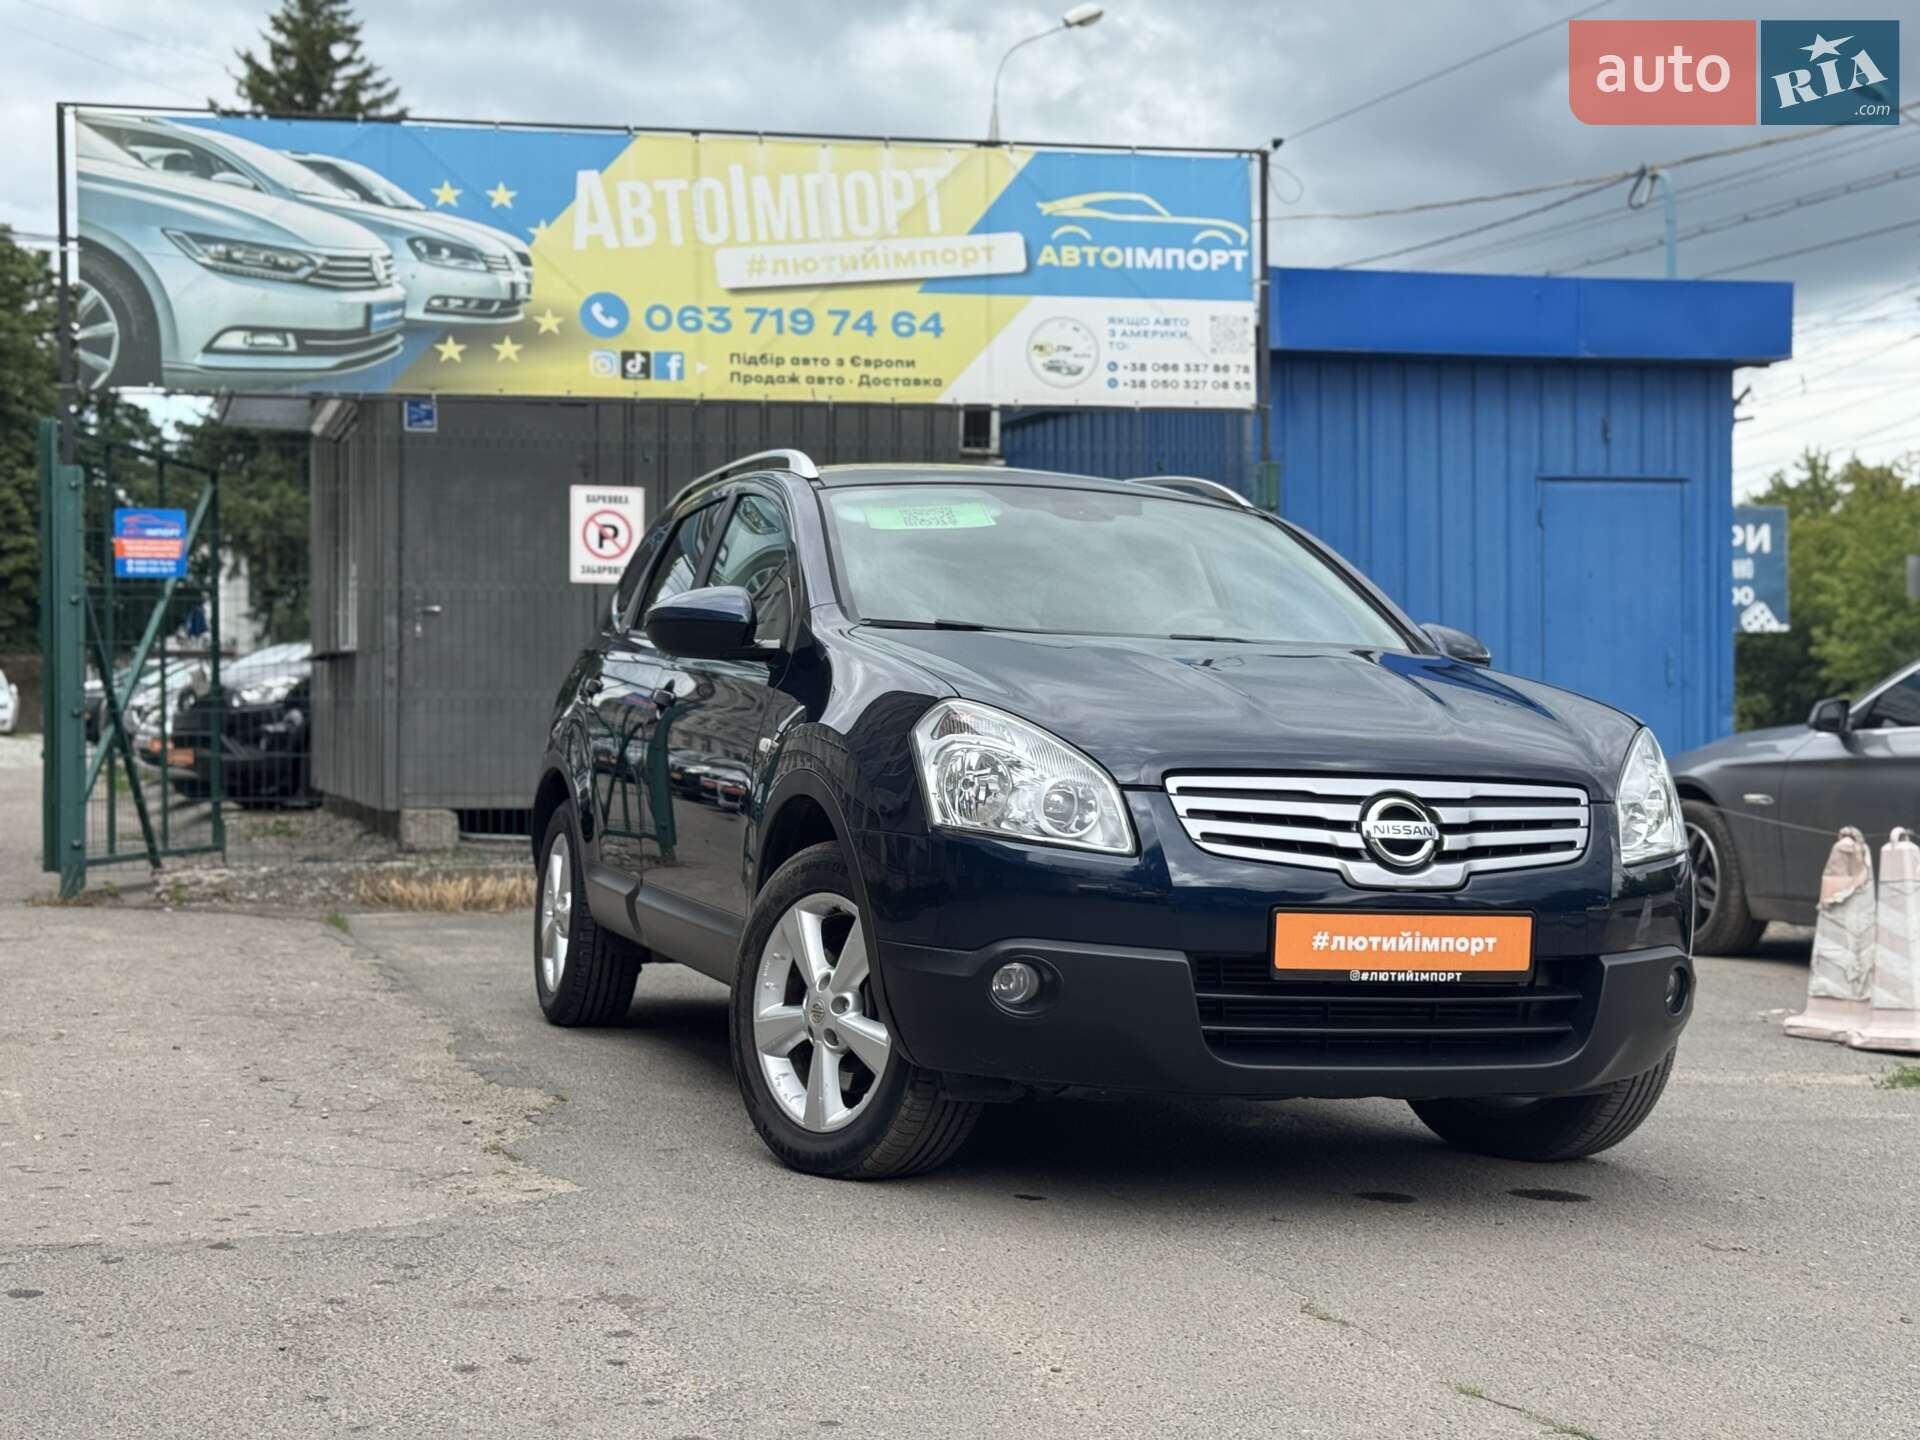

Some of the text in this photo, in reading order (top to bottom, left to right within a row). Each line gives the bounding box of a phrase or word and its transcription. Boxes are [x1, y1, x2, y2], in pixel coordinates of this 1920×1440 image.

[745, 243, 997, 279] #лютийімпорт
[1038, 245, 1248, 271] АВТОІМПОРТ
[645, 303, 944, 338] 063 719 74 64
[1154, 317, 1190, 327] АВТО
[729, 353, 785, 368] Підбір
[790, 357, 830, 367] авто
[850, 355, 916, 369] Європи
[729, 371, 943, 388] Продаж авто Доставка
[1373, 824, 1434, 837] NISSAN
[1312, 931, 1498, 956] #лютийімпорт
